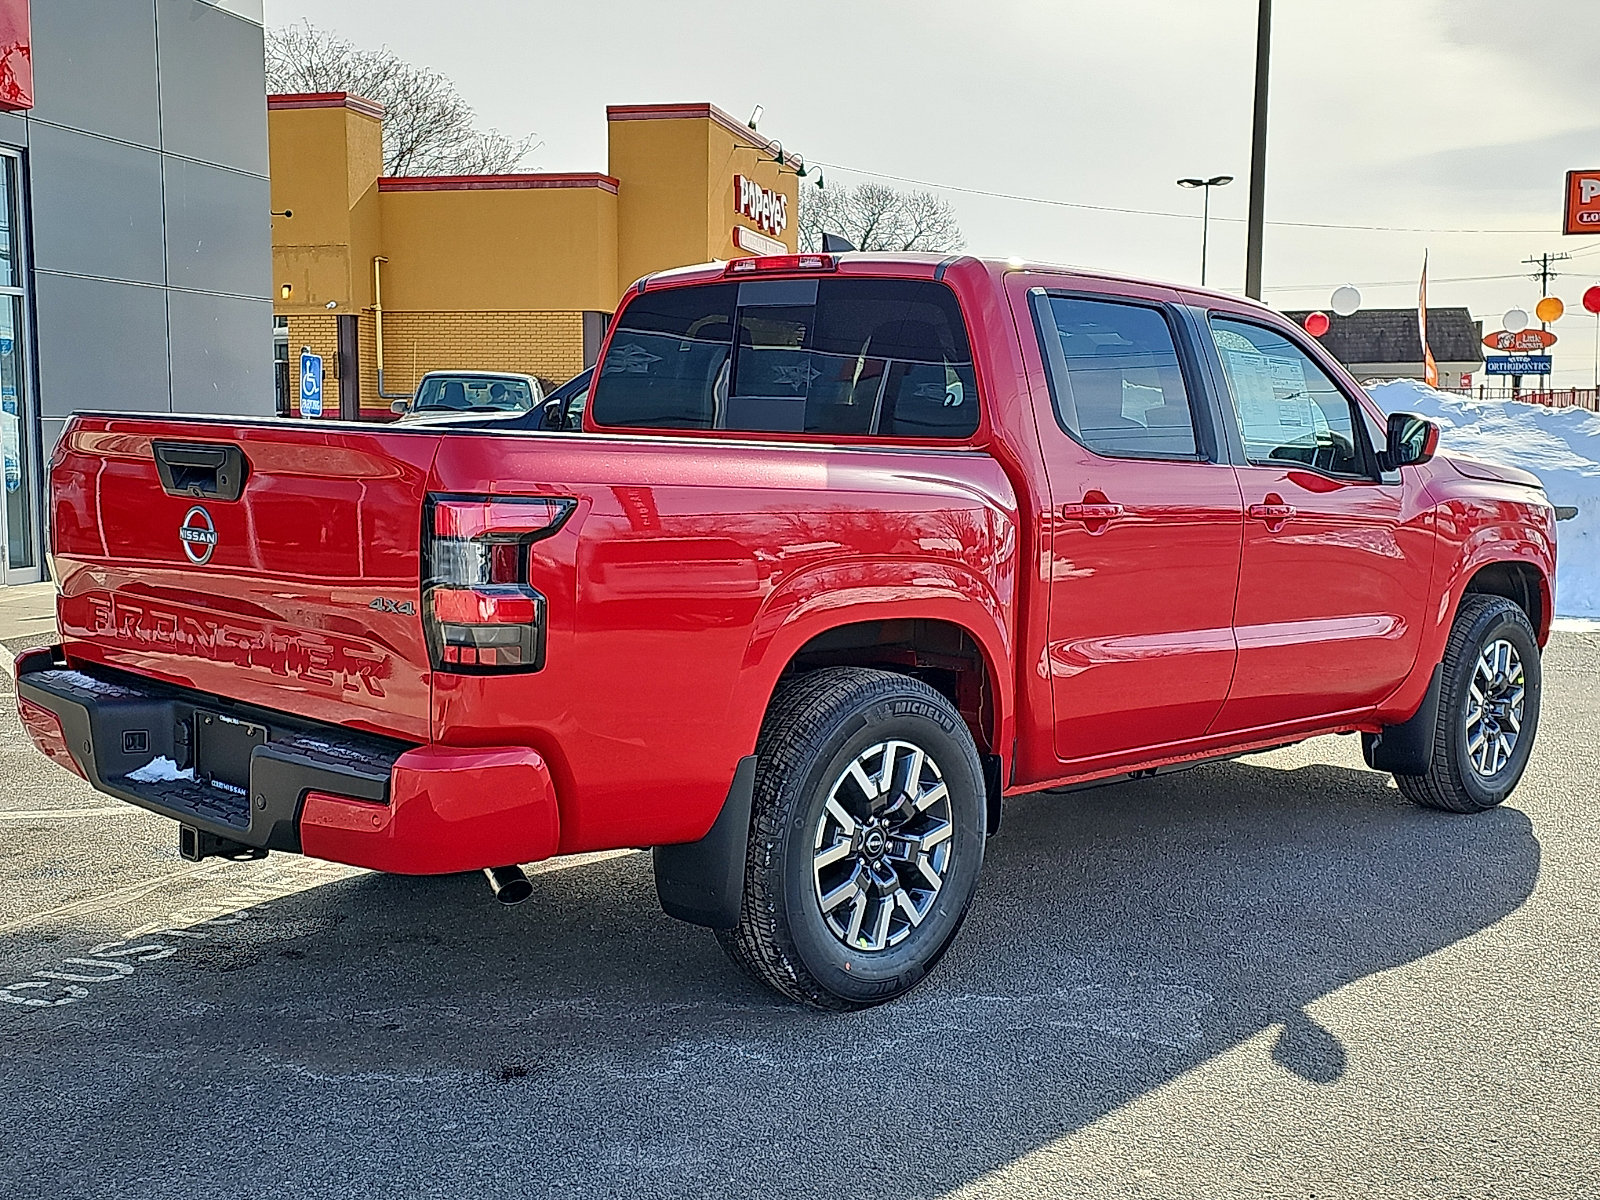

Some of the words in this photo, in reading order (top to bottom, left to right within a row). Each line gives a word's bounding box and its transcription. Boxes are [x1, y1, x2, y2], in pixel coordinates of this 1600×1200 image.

[1582, 213, 1600, 222] LO
[1487, 362, 1551, 371] ORTHODONTICS
[180, 529, 215, 544] NISSAN
[87, 596, 387, 698] FRONTIER
[894, 701, 956, 731] MICHELIN
